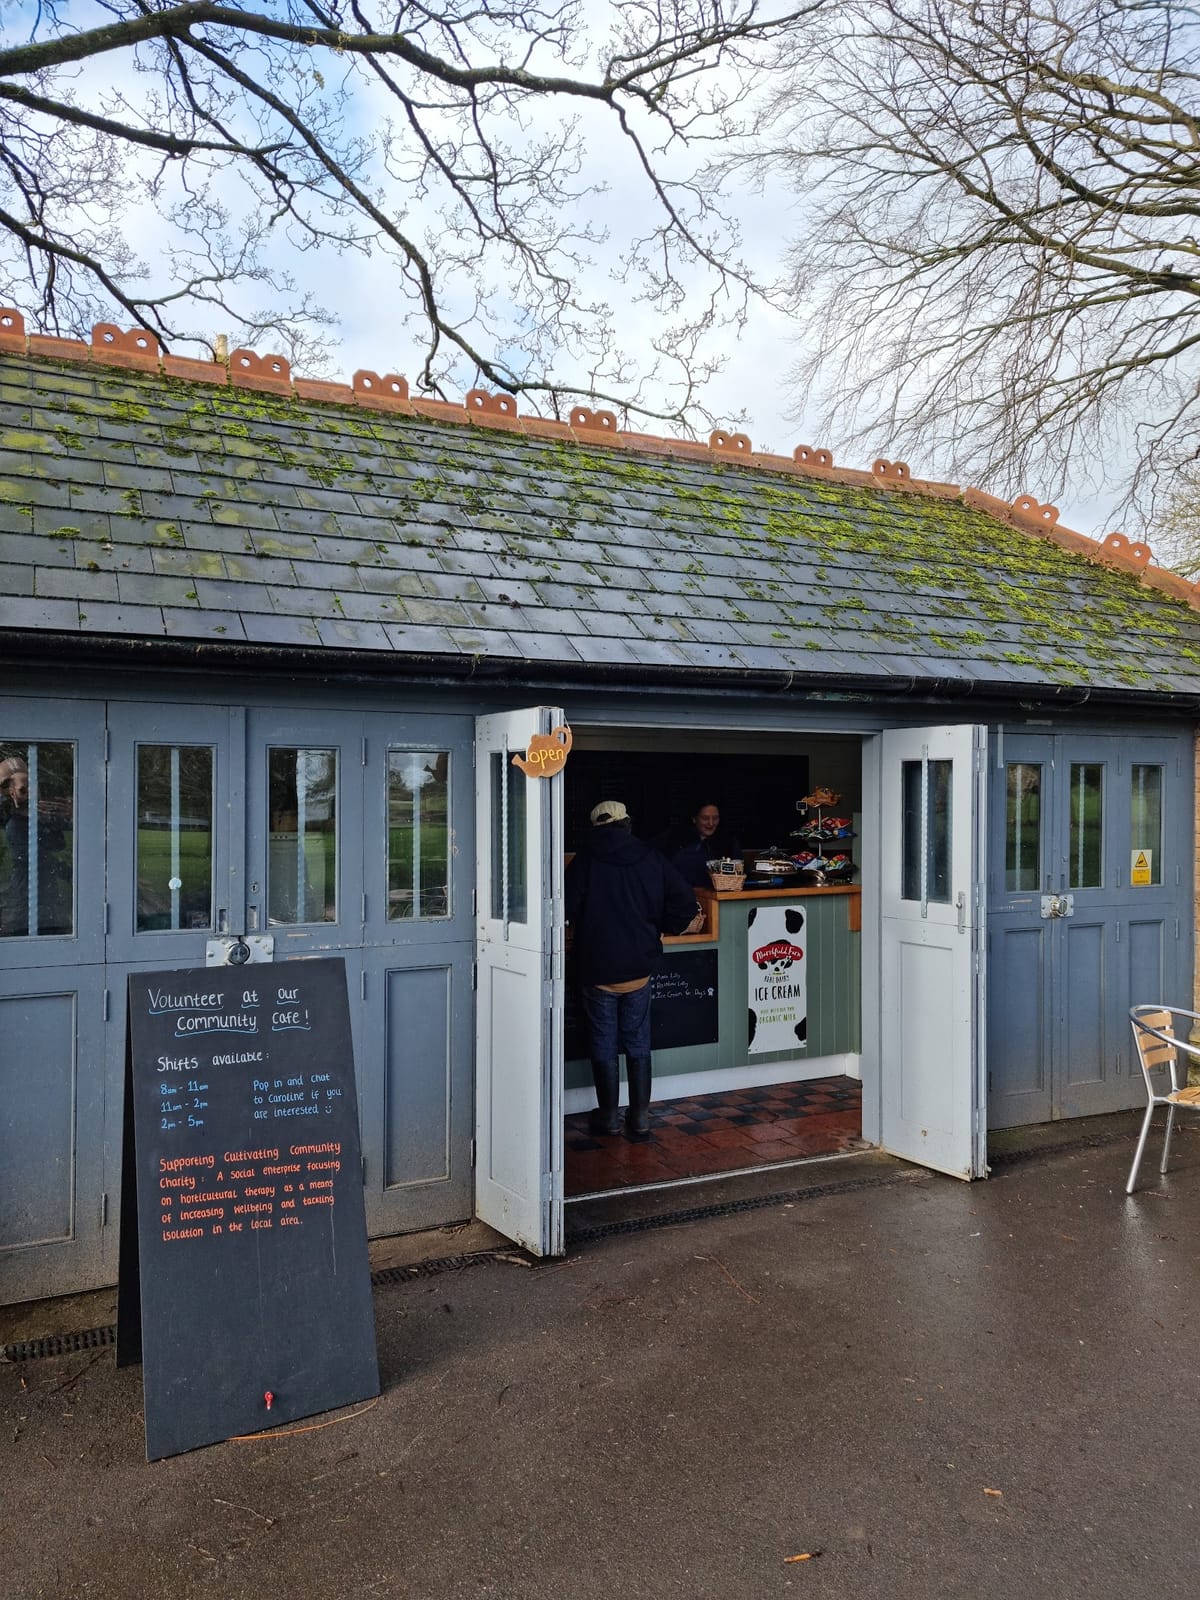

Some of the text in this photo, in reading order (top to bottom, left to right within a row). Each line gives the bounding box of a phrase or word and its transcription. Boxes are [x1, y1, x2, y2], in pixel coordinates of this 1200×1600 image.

[529, 749, 564, 769] open
[148, 987, 299, 1009] Volunteer at our
[755, 983, 801, 1001] ICE CREAM
[157, 1056, 199, 1072] Shifts
[160, 1083, 177, 1096] 8am
[187, 1080, 209, 1092] 11am
[253, 1079, 269, 1092] Pop
[274, 1078, 283, 1088] in
[287, 1075, 303, 1087] and
[253, 1095, 263, 1105] to
[311, 1088, 320, 1100] if
[326, 1087, 342, 1100] you
[160, 1101, 182, 1113] 11am
[193, 1098, 209, 1110] 2pm
[253, 1103, 319, 1119] are interested
[161, 1117, 176, 1130] 2pm
[188, 1115, 204, 1128] 5pm
[159, 1153, 216, 1173] Supporting
[223, 1147, 280, 1163] Cultivating
[216, 1171, 224, 1182] A
[262, 1163, 301, 1176] enterprise
[306, 1159, 341, 1174] focusing
[161, 1178, 334, 1207] on horticultural therapy as a means
[161, 1194, 335, 1225] of increasing wellbeing and tackling
[162, 1215, 304, 1242] isolation in the local area.
